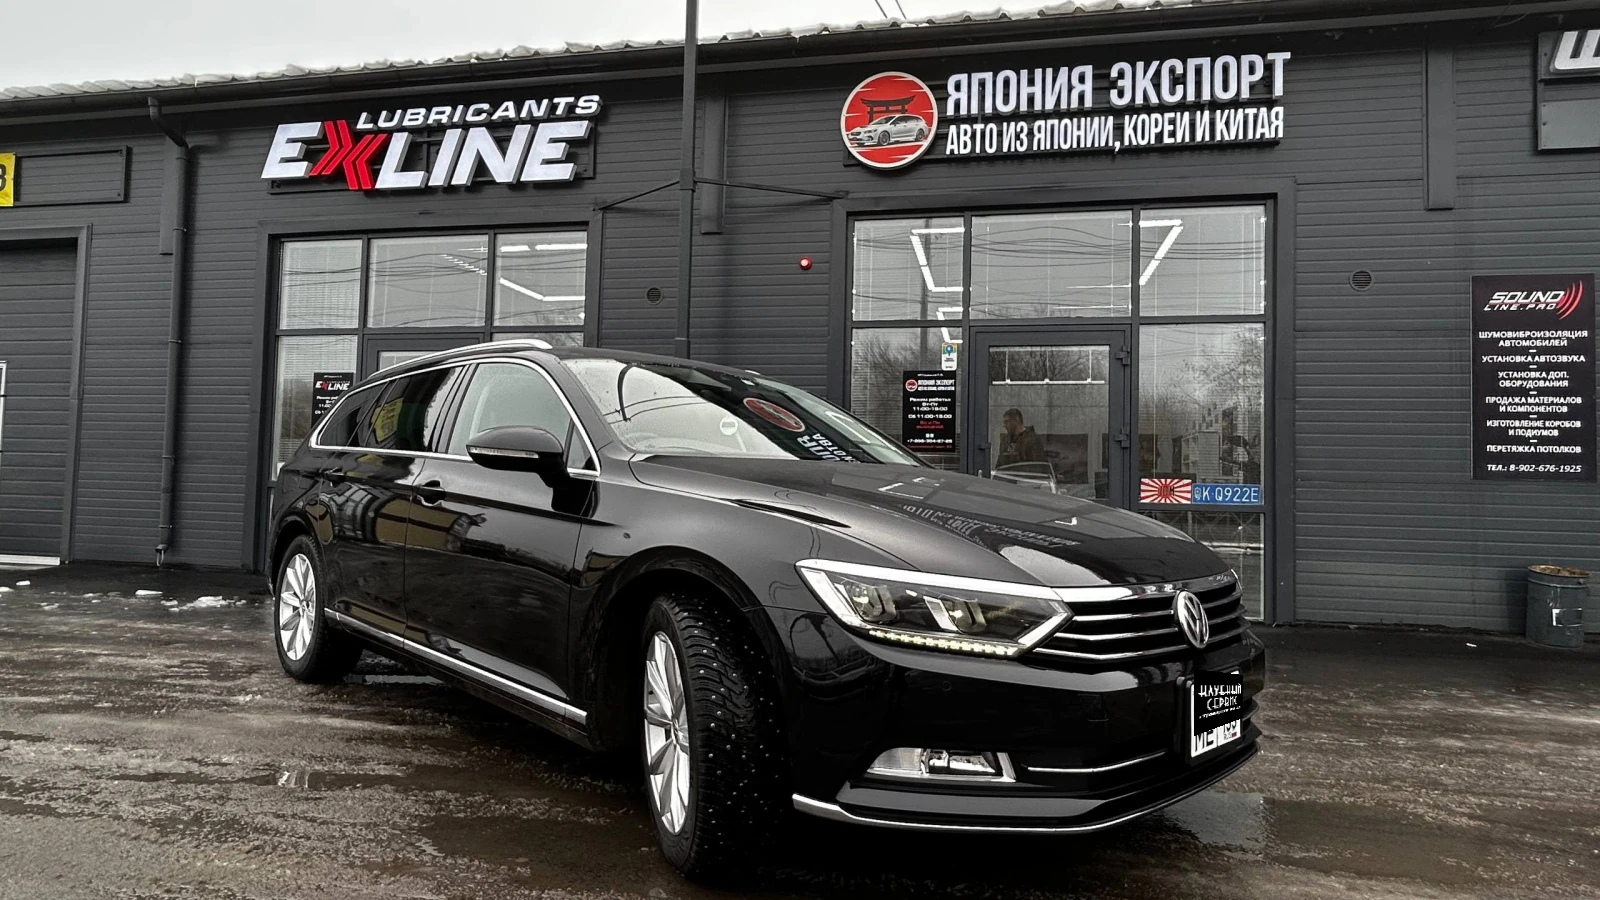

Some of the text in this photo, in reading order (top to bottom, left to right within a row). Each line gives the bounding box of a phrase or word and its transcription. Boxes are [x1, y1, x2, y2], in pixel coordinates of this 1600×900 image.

[946, 51, 1292, 116] ЯПОНИЯ ЭКСПОРТ
[356, 94, 601, 131] LUBRICANTS
[945, 106, 1284, 156] АВТО ИЗ ЯПОНИИ, КОРЕИ И КИТАЯ
[261, 120, 591, 190] EXLINE
[1488, 290, 1565, 304] SOUND
[1483, 303, 1558, 312] LINE.PRO
[1478, 330, 1588, 340] ШУМОВИБРОИЗОЛЯЦИЯ
[1498, 338, 1568, 347] АВТОМОБИЛЕЙ
[1548, 371, 1570, 380] ДОП.
[1499, 380, 1568, 388] ОБОРУДОВАНИЯ
[1486, 396, 1526, 405] ПРОДАЖА
[1516, 429, 1559, 438] ПОДИУМОВ
[1536, 445, 1582, 453] ПОТОЛКОВ
[1509, 464, 1582, 472] 8-902-676-1925
